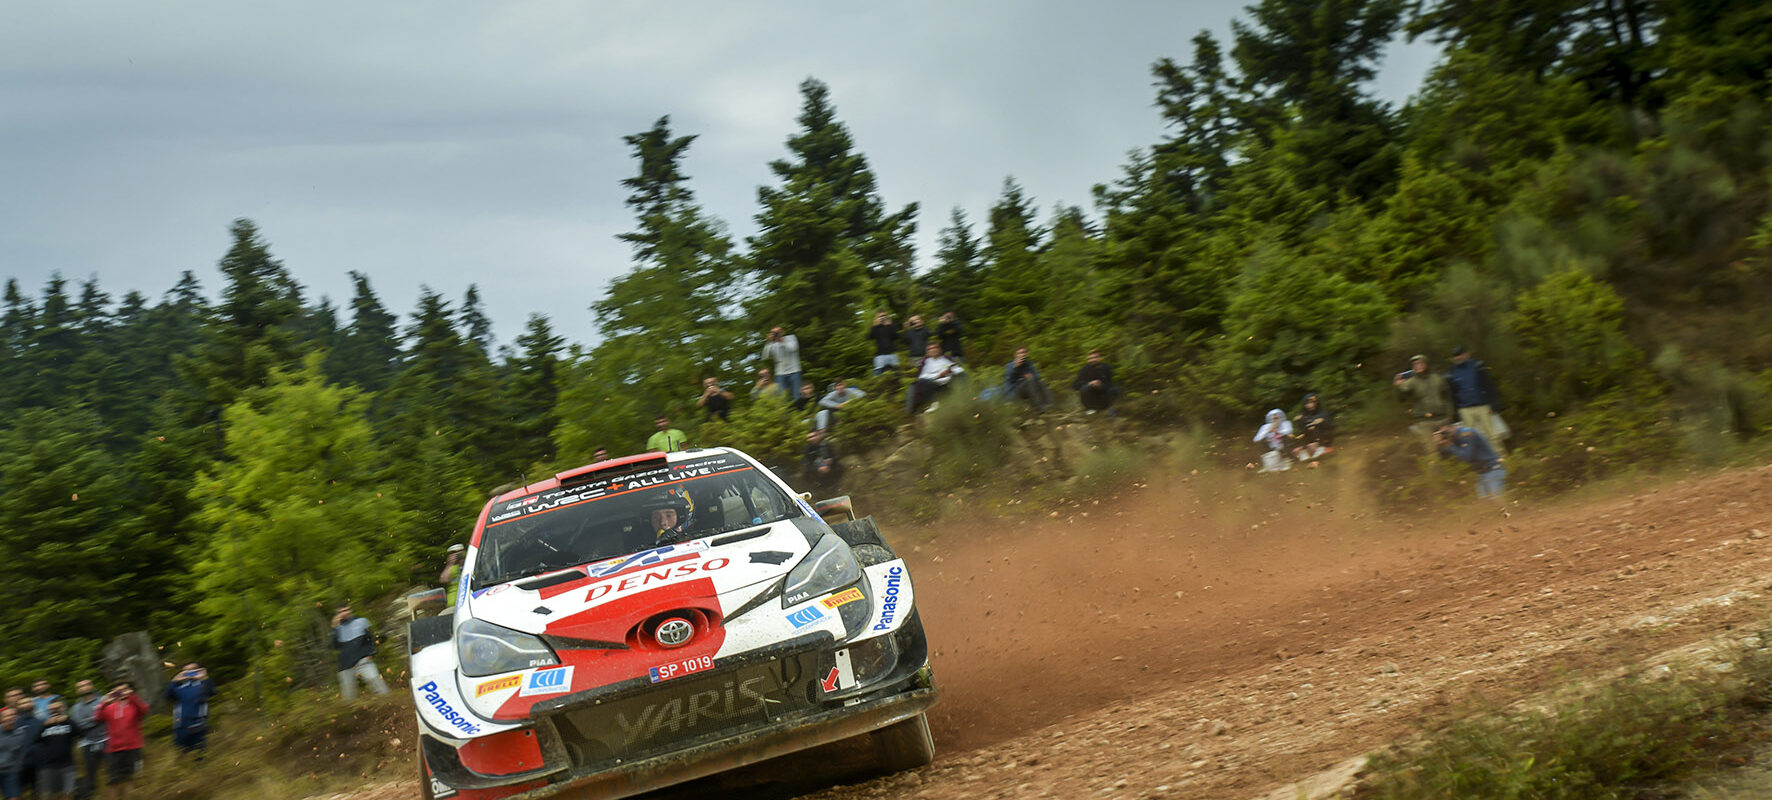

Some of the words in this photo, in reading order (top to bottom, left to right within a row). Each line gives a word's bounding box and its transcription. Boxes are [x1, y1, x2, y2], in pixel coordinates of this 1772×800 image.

[543, 480, 607, 500] TOYOTA
[611, 468, 669, 483] GAZOO
[673, 458, 726, 471] Racing
[628, 479, 664, 490] ALL
[668, 467, 711, 481] LIVE
[584, 558, 730, 603] DENSO
[787, 591, 810, 604] PIAA
[824, 589, 860, 607] PIRELLI
[873, 566, 902, 631] Panasonic
[529, 658, 554, 667] PIAA
[659, 663, 678, 678] SP
[682, 656, 711, 673] 1019
[477, 676, 519, 697] PIRELLI
[418, 680, 481, 735] Panasonic
